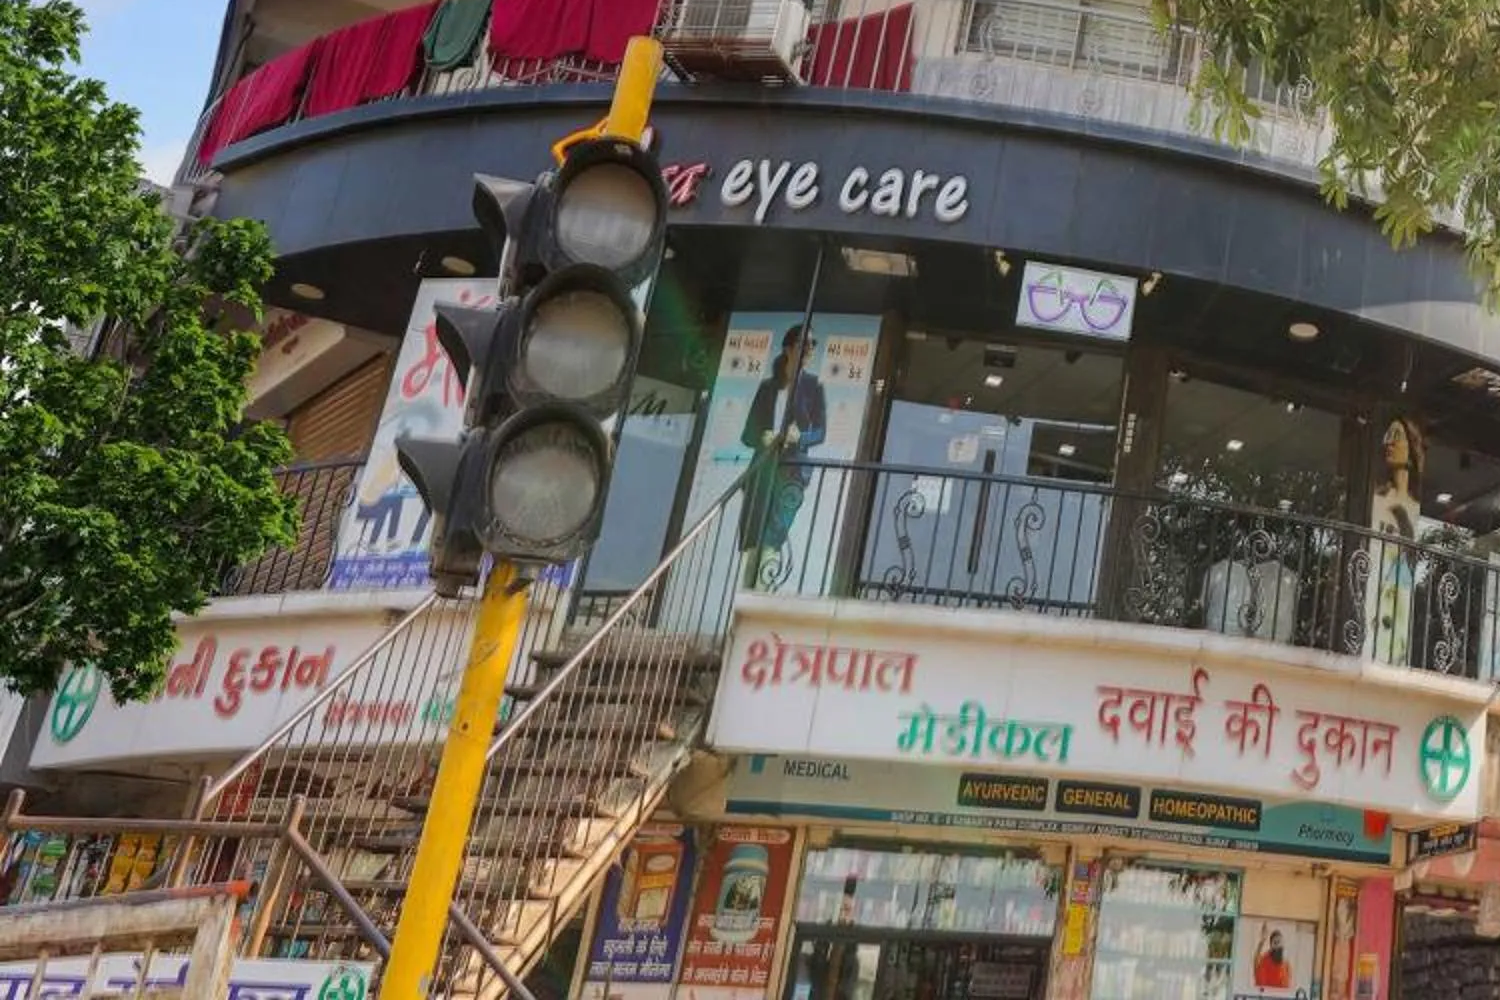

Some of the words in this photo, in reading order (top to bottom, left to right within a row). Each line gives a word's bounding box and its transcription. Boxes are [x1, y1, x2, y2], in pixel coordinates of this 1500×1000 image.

[720, 158, 820, 224] eye
[838, 166, 968, 222] care
[215, 645, 336, 718] દુકાન
[741, 631, 920, 692] क्षेत्रपाल
[897, 700, 1074, 763] मेडीकल
[1096, 667, 1212, 760] दवाई
[1224, 682, 1283, 762] की
[1290, 708, 1400, 791] दुकान
[783, 759, 850, 780] MEDICAL
[963, 781, 1046, 803] AYURVEDIC
[1063, 788, 1133, 810] GENERAL
[1152, 797, 1257, 824] HOMEOPATHIC
